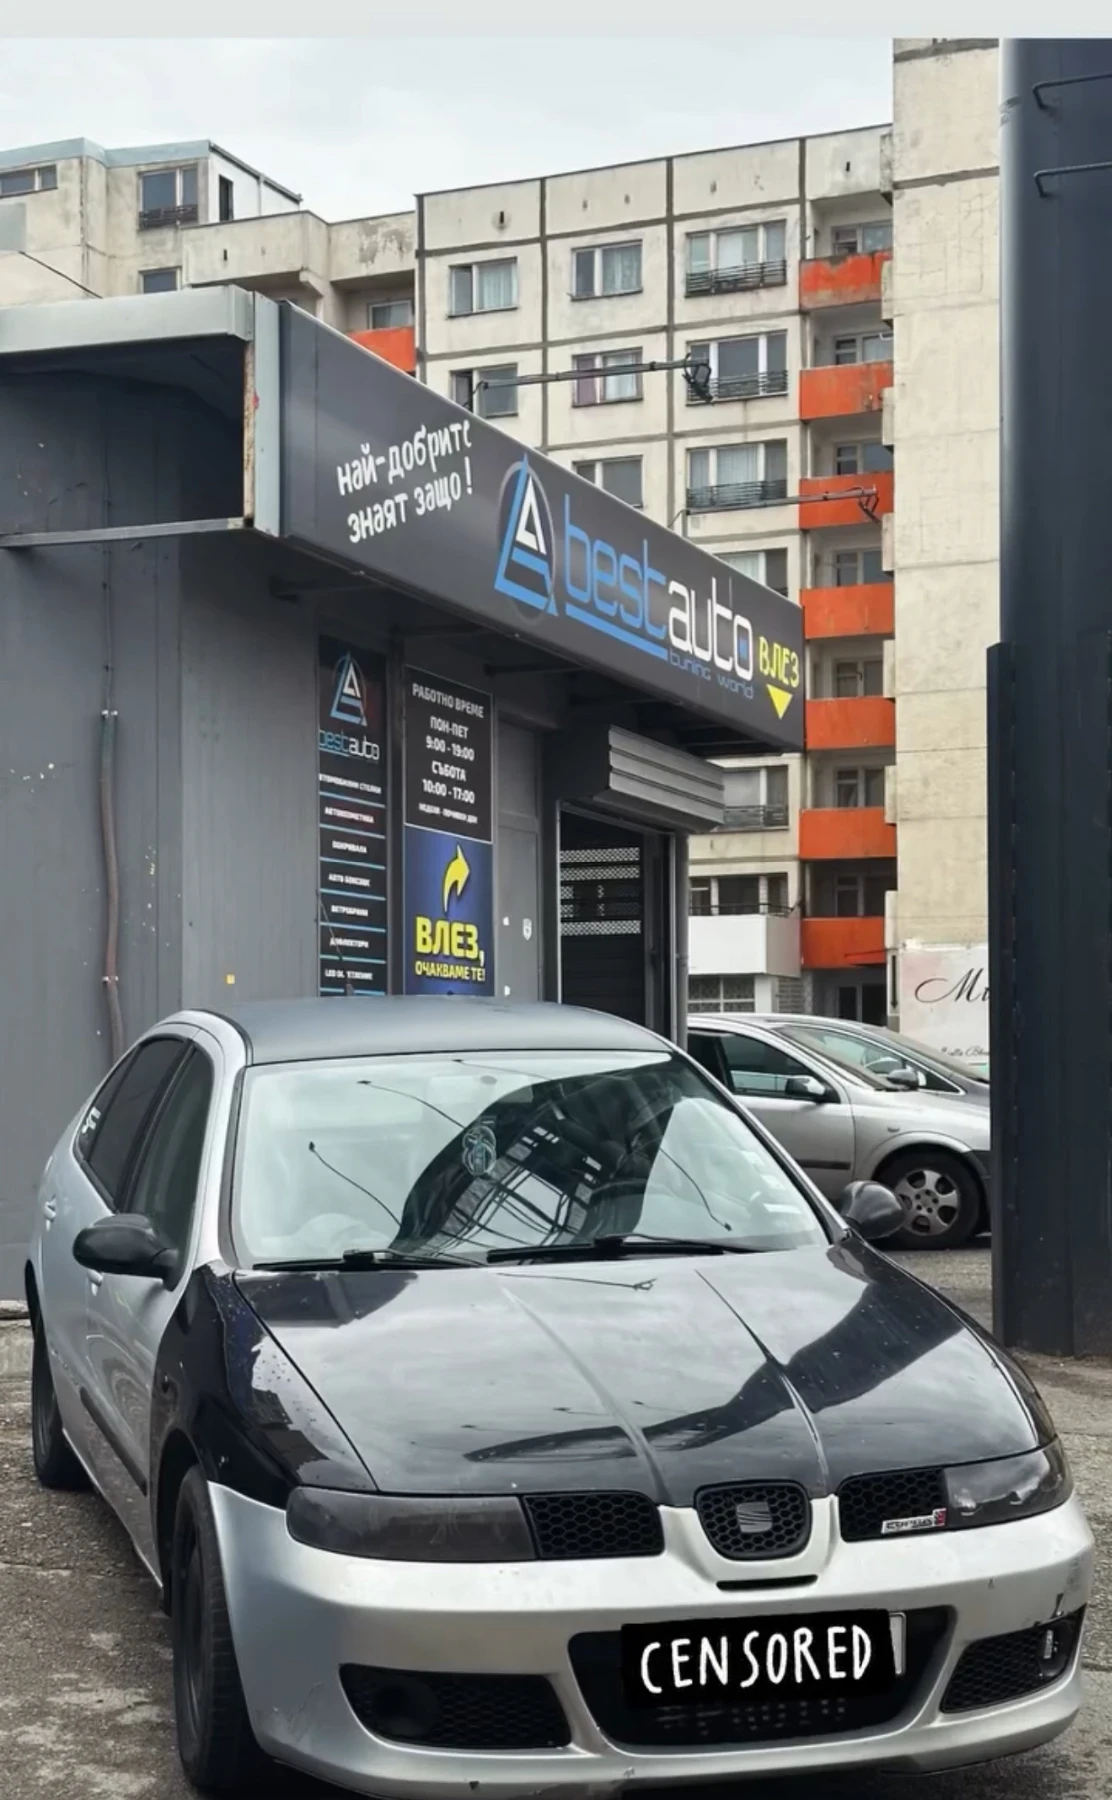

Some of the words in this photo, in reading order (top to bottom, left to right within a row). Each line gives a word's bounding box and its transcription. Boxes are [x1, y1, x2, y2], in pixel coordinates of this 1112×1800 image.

[347, 492, 408, 544] знаят
[758, 634, 800, 689] ВЛЕЗ
[717, 674, 755, 700] world
[412, 683, 454, 709] РАБОТНО
[455, 697, 485, 719] ВРЕМЕ
[430, 716, 469, 740] ПОН-ПЕТ
[425, 735, 447, 754] 9:00
[451, 742, 475, 762] 19:00
[431, 760, 467, 782] СЪБОТА
[422, 778, 447, 797] 10:00
[452, 786, 476, 804] 17:00
[415, 916, 485, 967] ВЛЕЗ,
[415, 961, 470, 979] ОЧАКВАМЕ
[471, 966, 486, 981] ТЕ!
